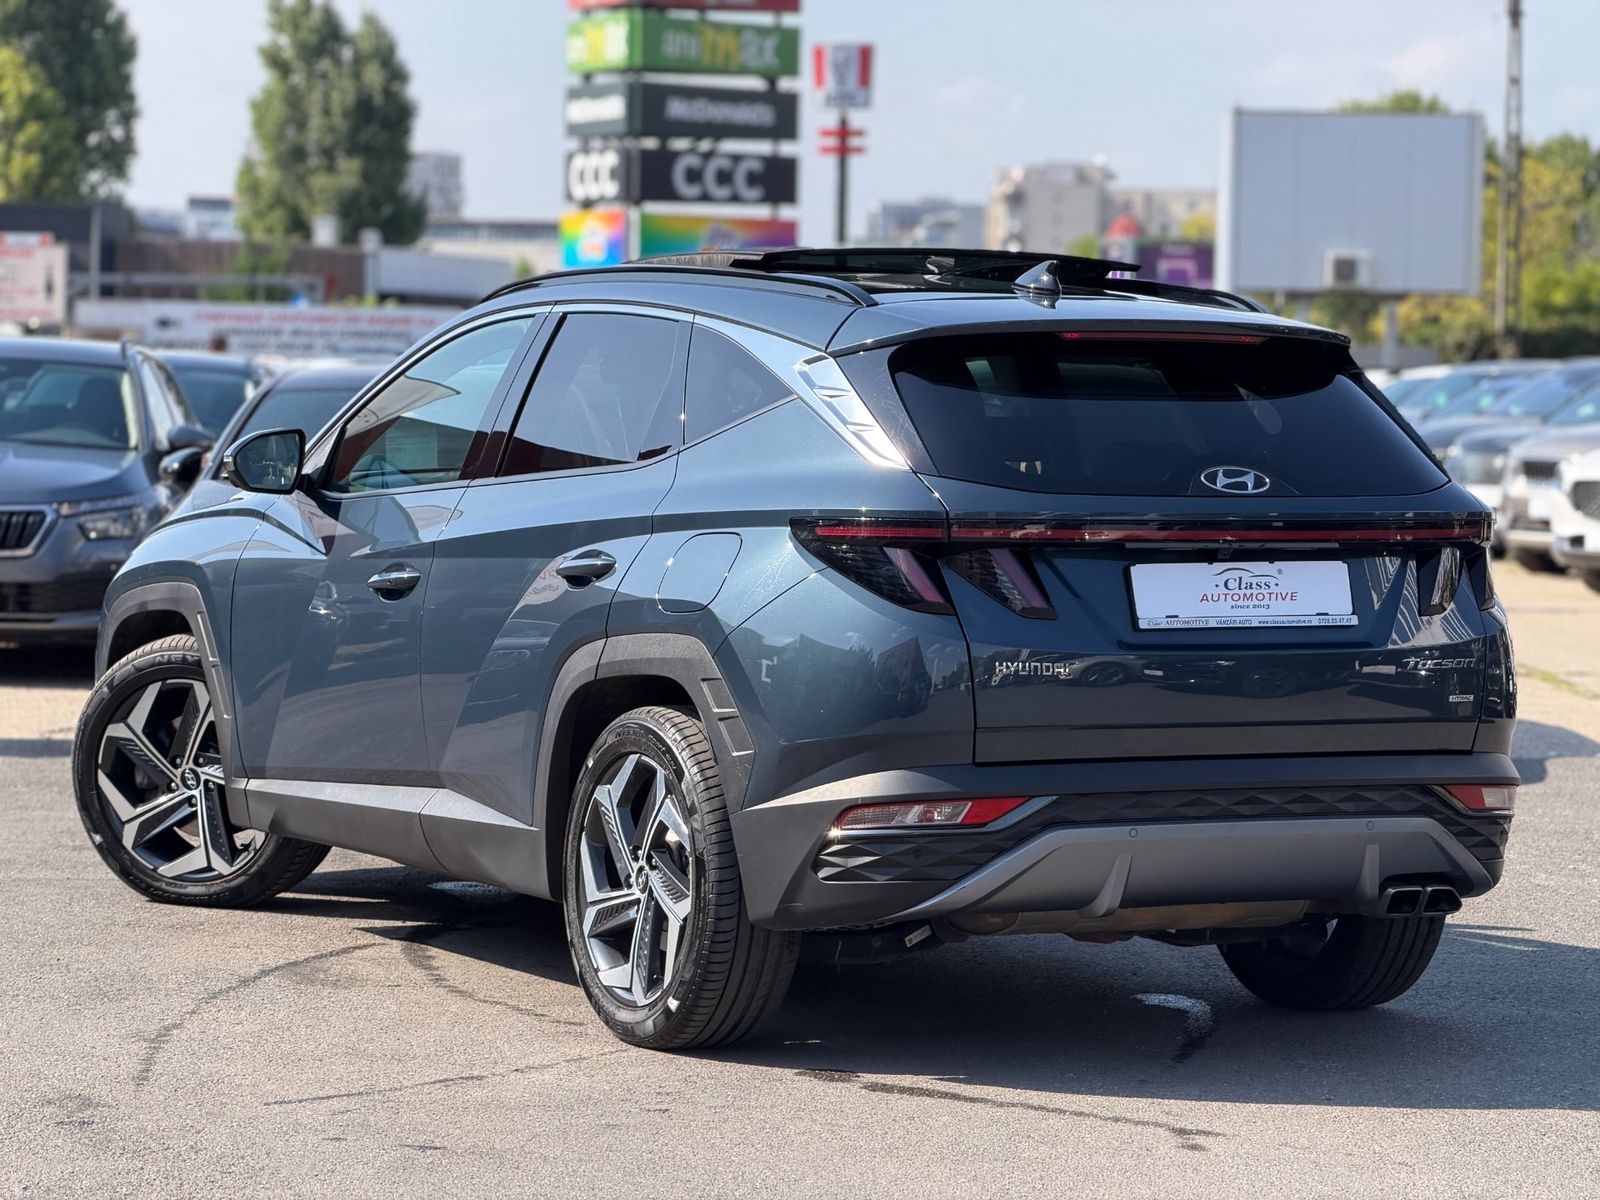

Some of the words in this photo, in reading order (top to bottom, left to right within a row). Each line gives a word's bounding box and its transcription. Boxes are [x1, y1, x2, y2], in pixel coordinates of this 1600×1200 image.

[671, 153, 766, 200] CCC
[1223, 576, 1271, 591] Class
[1200, 591, 1298, 603] AUTOMOTIVE
[1165, 618, 1209, 627] AUTOMOTIVE
[1239, 618, 1253, 626] AUTO
[995, 661, 1070, 676] HYUNDAI
